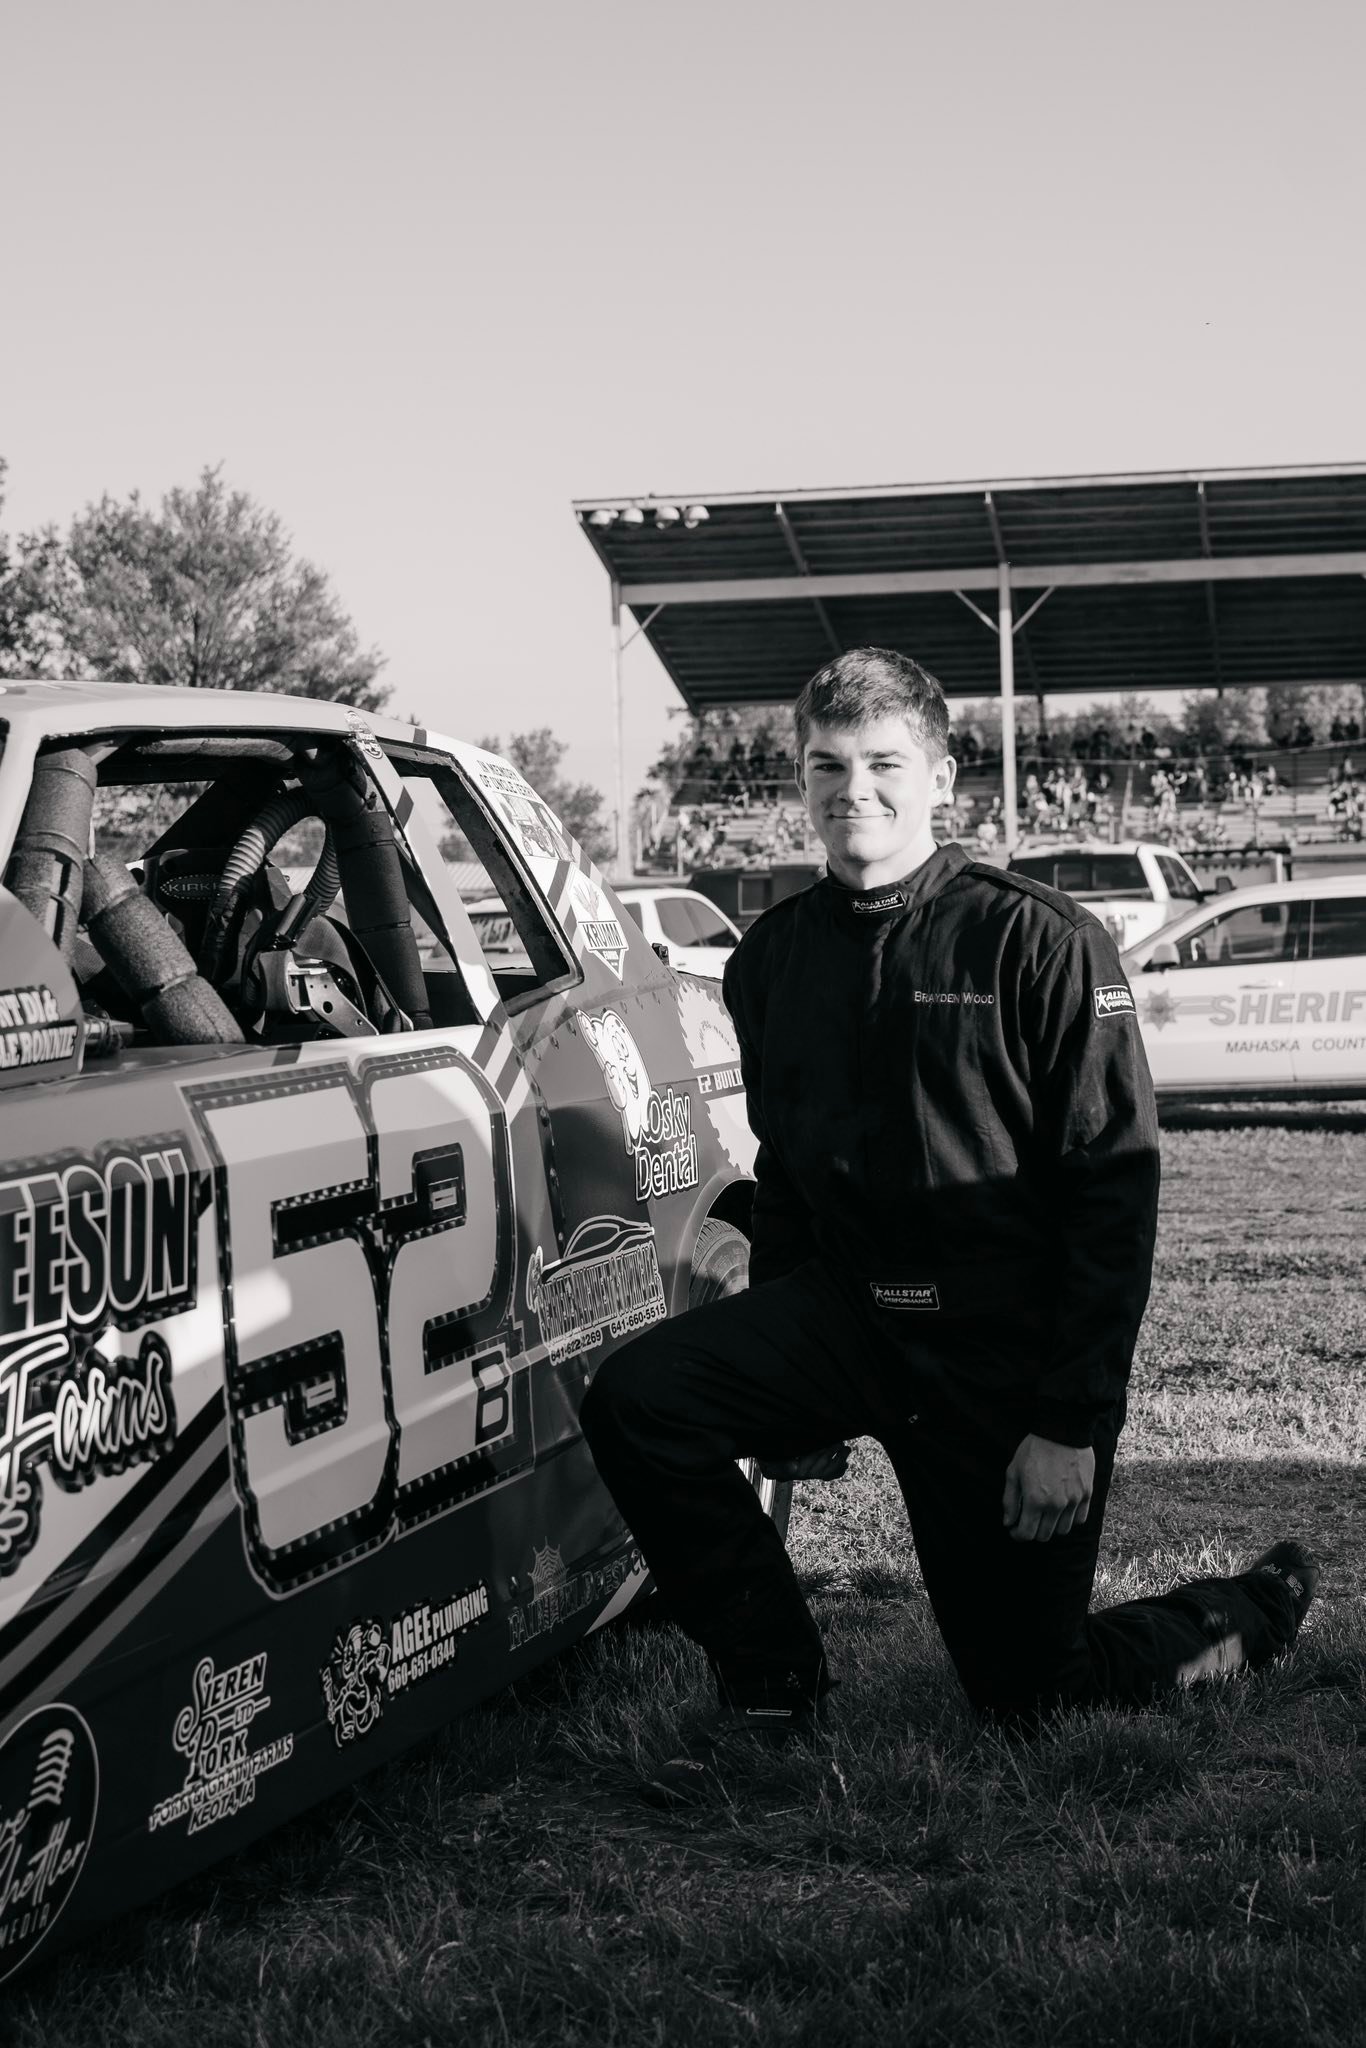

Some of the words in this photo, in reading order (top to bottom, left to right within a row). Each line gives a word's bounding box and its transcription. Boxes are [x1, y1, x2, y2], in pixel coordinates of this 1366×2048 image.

[582, 923, 624, 947] KRUMM
[18, 1025, 79, 1065] RONNIE
[1226, 1039, 1301, 1053] MAHASKA
[648, 1087, 690, 1151] Osky
[636, 1134, 699, 1201] Dental
[192, 1055, 520, 1570] 52
[884, 1289, 931, 1297] ALLSTAR
[392, 1605, 433, 1664] AGEE
[432, 1586, 489, 1642] PLUMBING
[387, 1635, 456, 1694] 660-651-0344
[234, 1700, 256, 1729] LTD
[186, 1716, 248, 1789] PORK
[251, 1734, 294, 1774] FARMS
